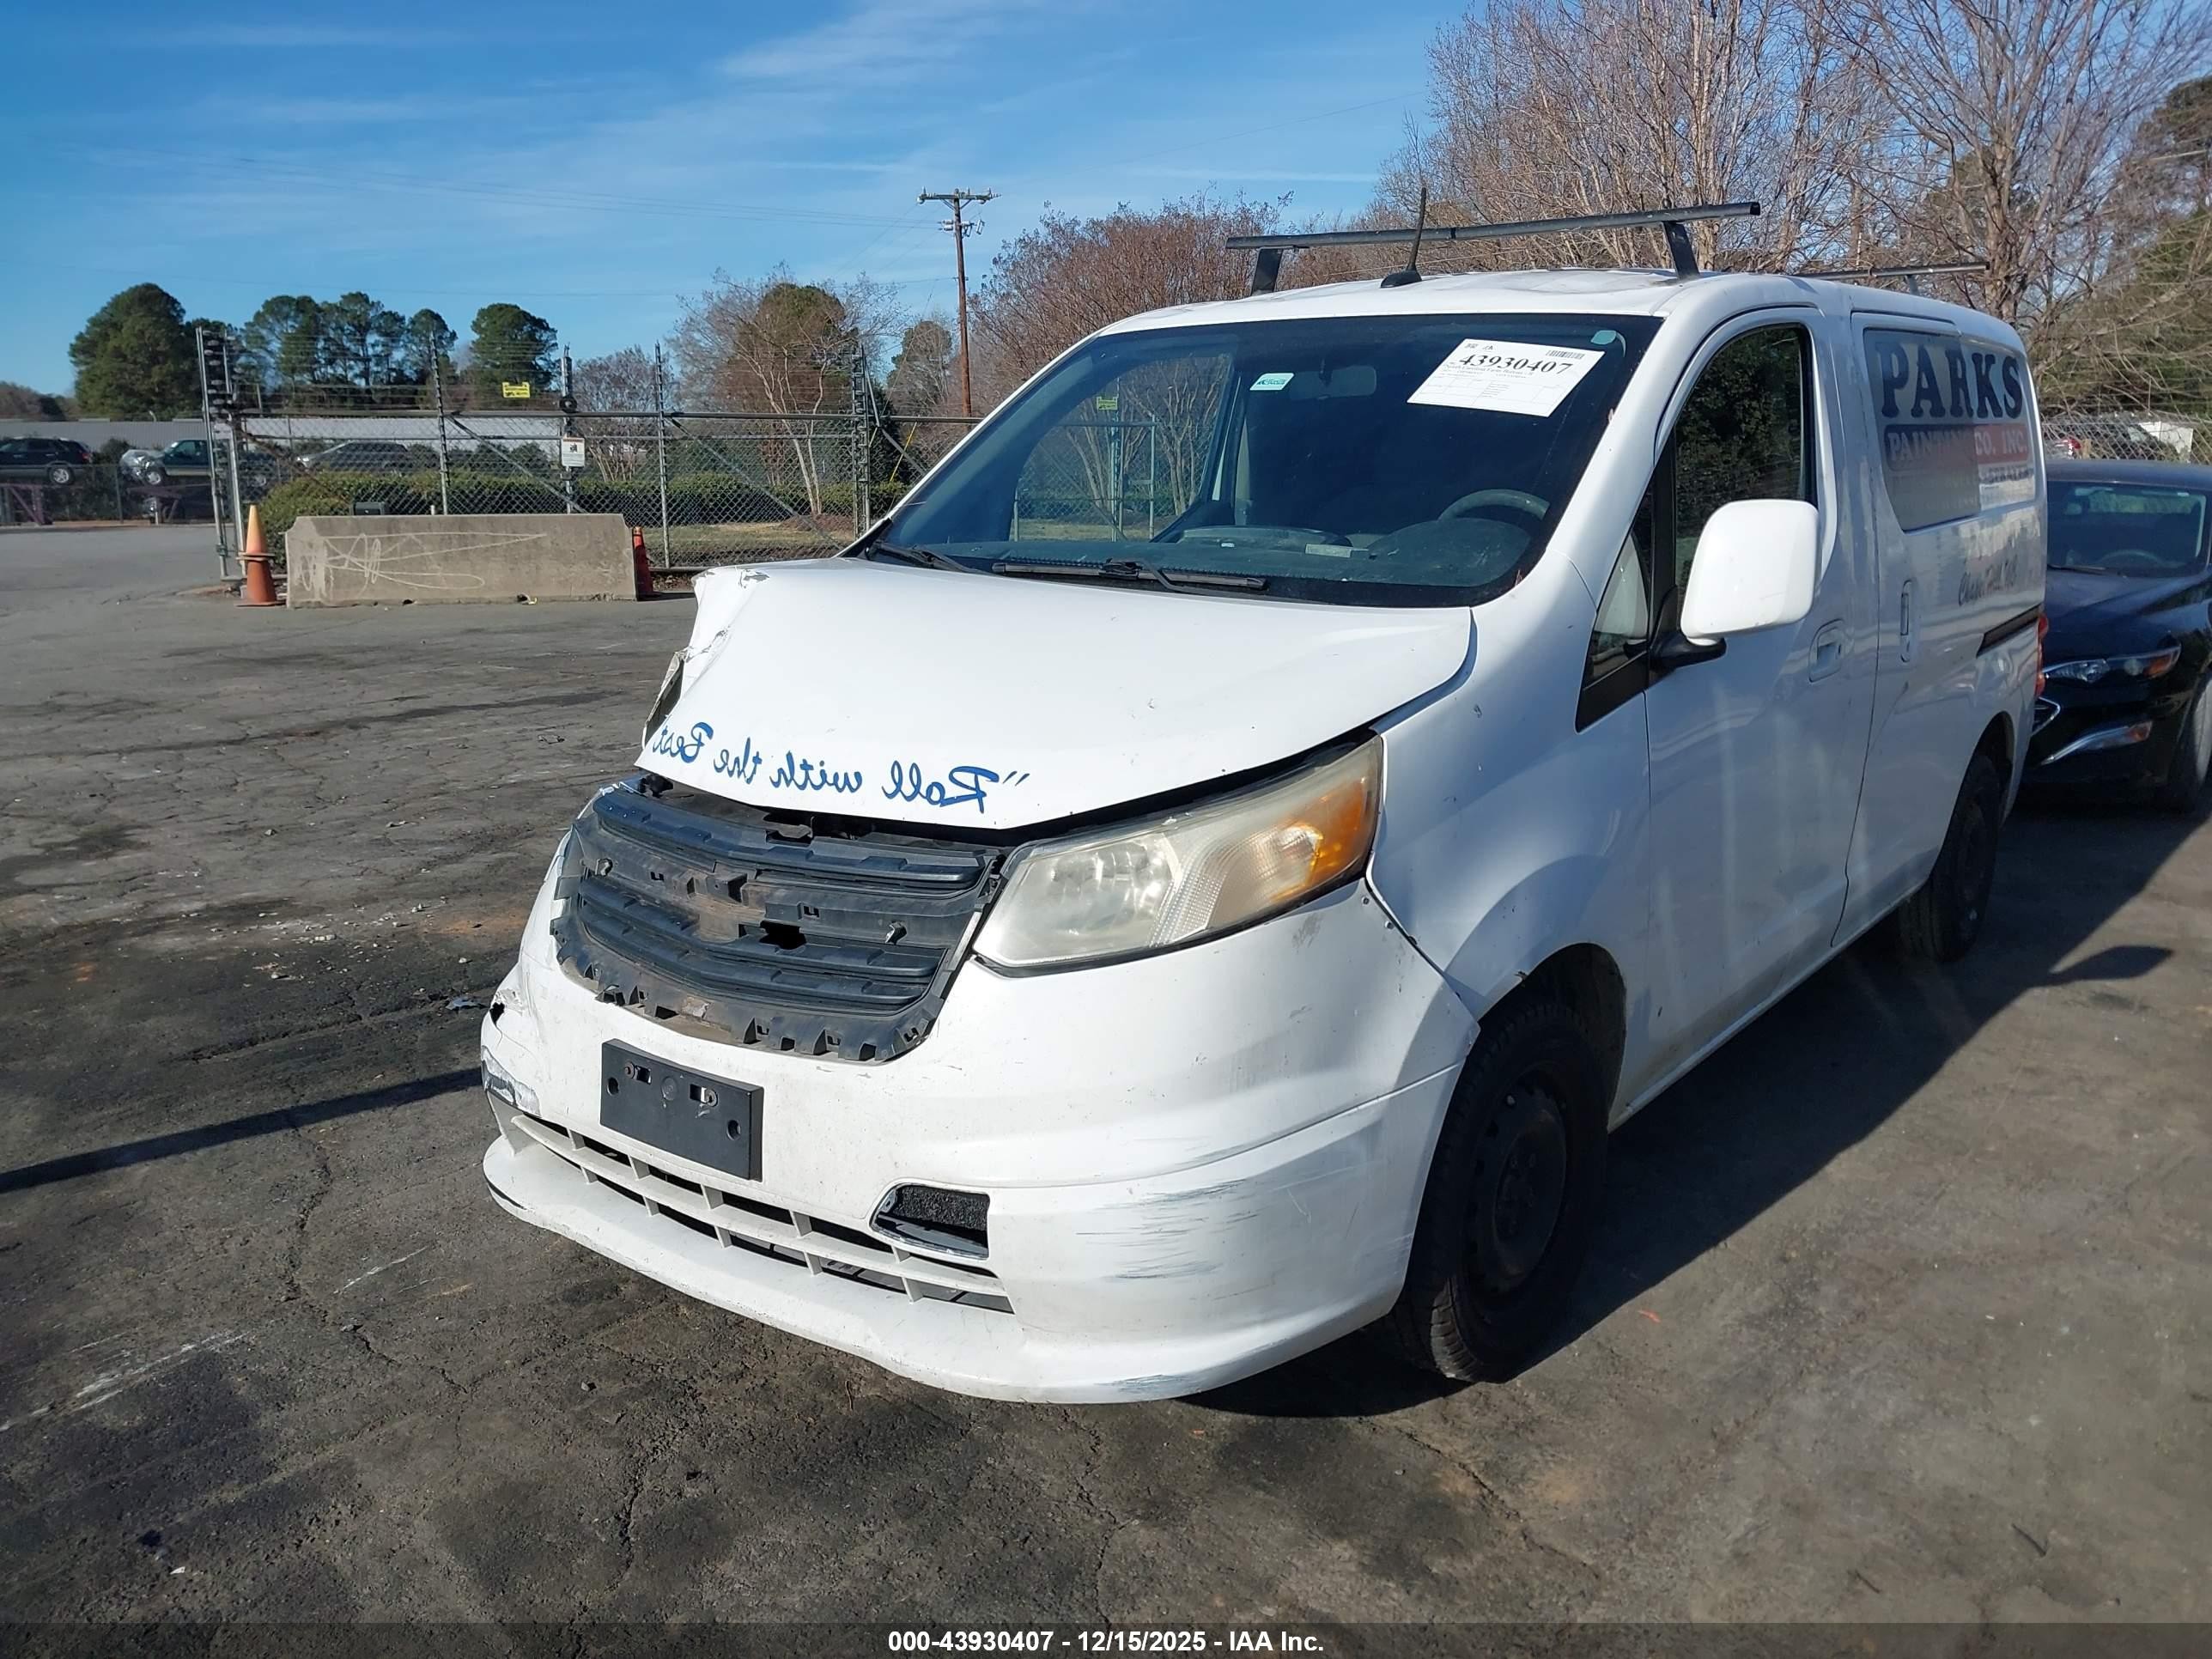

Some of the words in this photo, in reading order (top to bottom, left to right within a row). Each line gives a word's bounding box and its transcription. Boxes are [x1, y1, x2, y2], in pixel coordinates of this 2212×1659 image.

[1459, 353, 1574, 375] 43930407
[1875, 342, 2023, 419] PARKS
[1974, 431, 1996, 456] CO.
[2001, 430, 2027, 455] INC.
